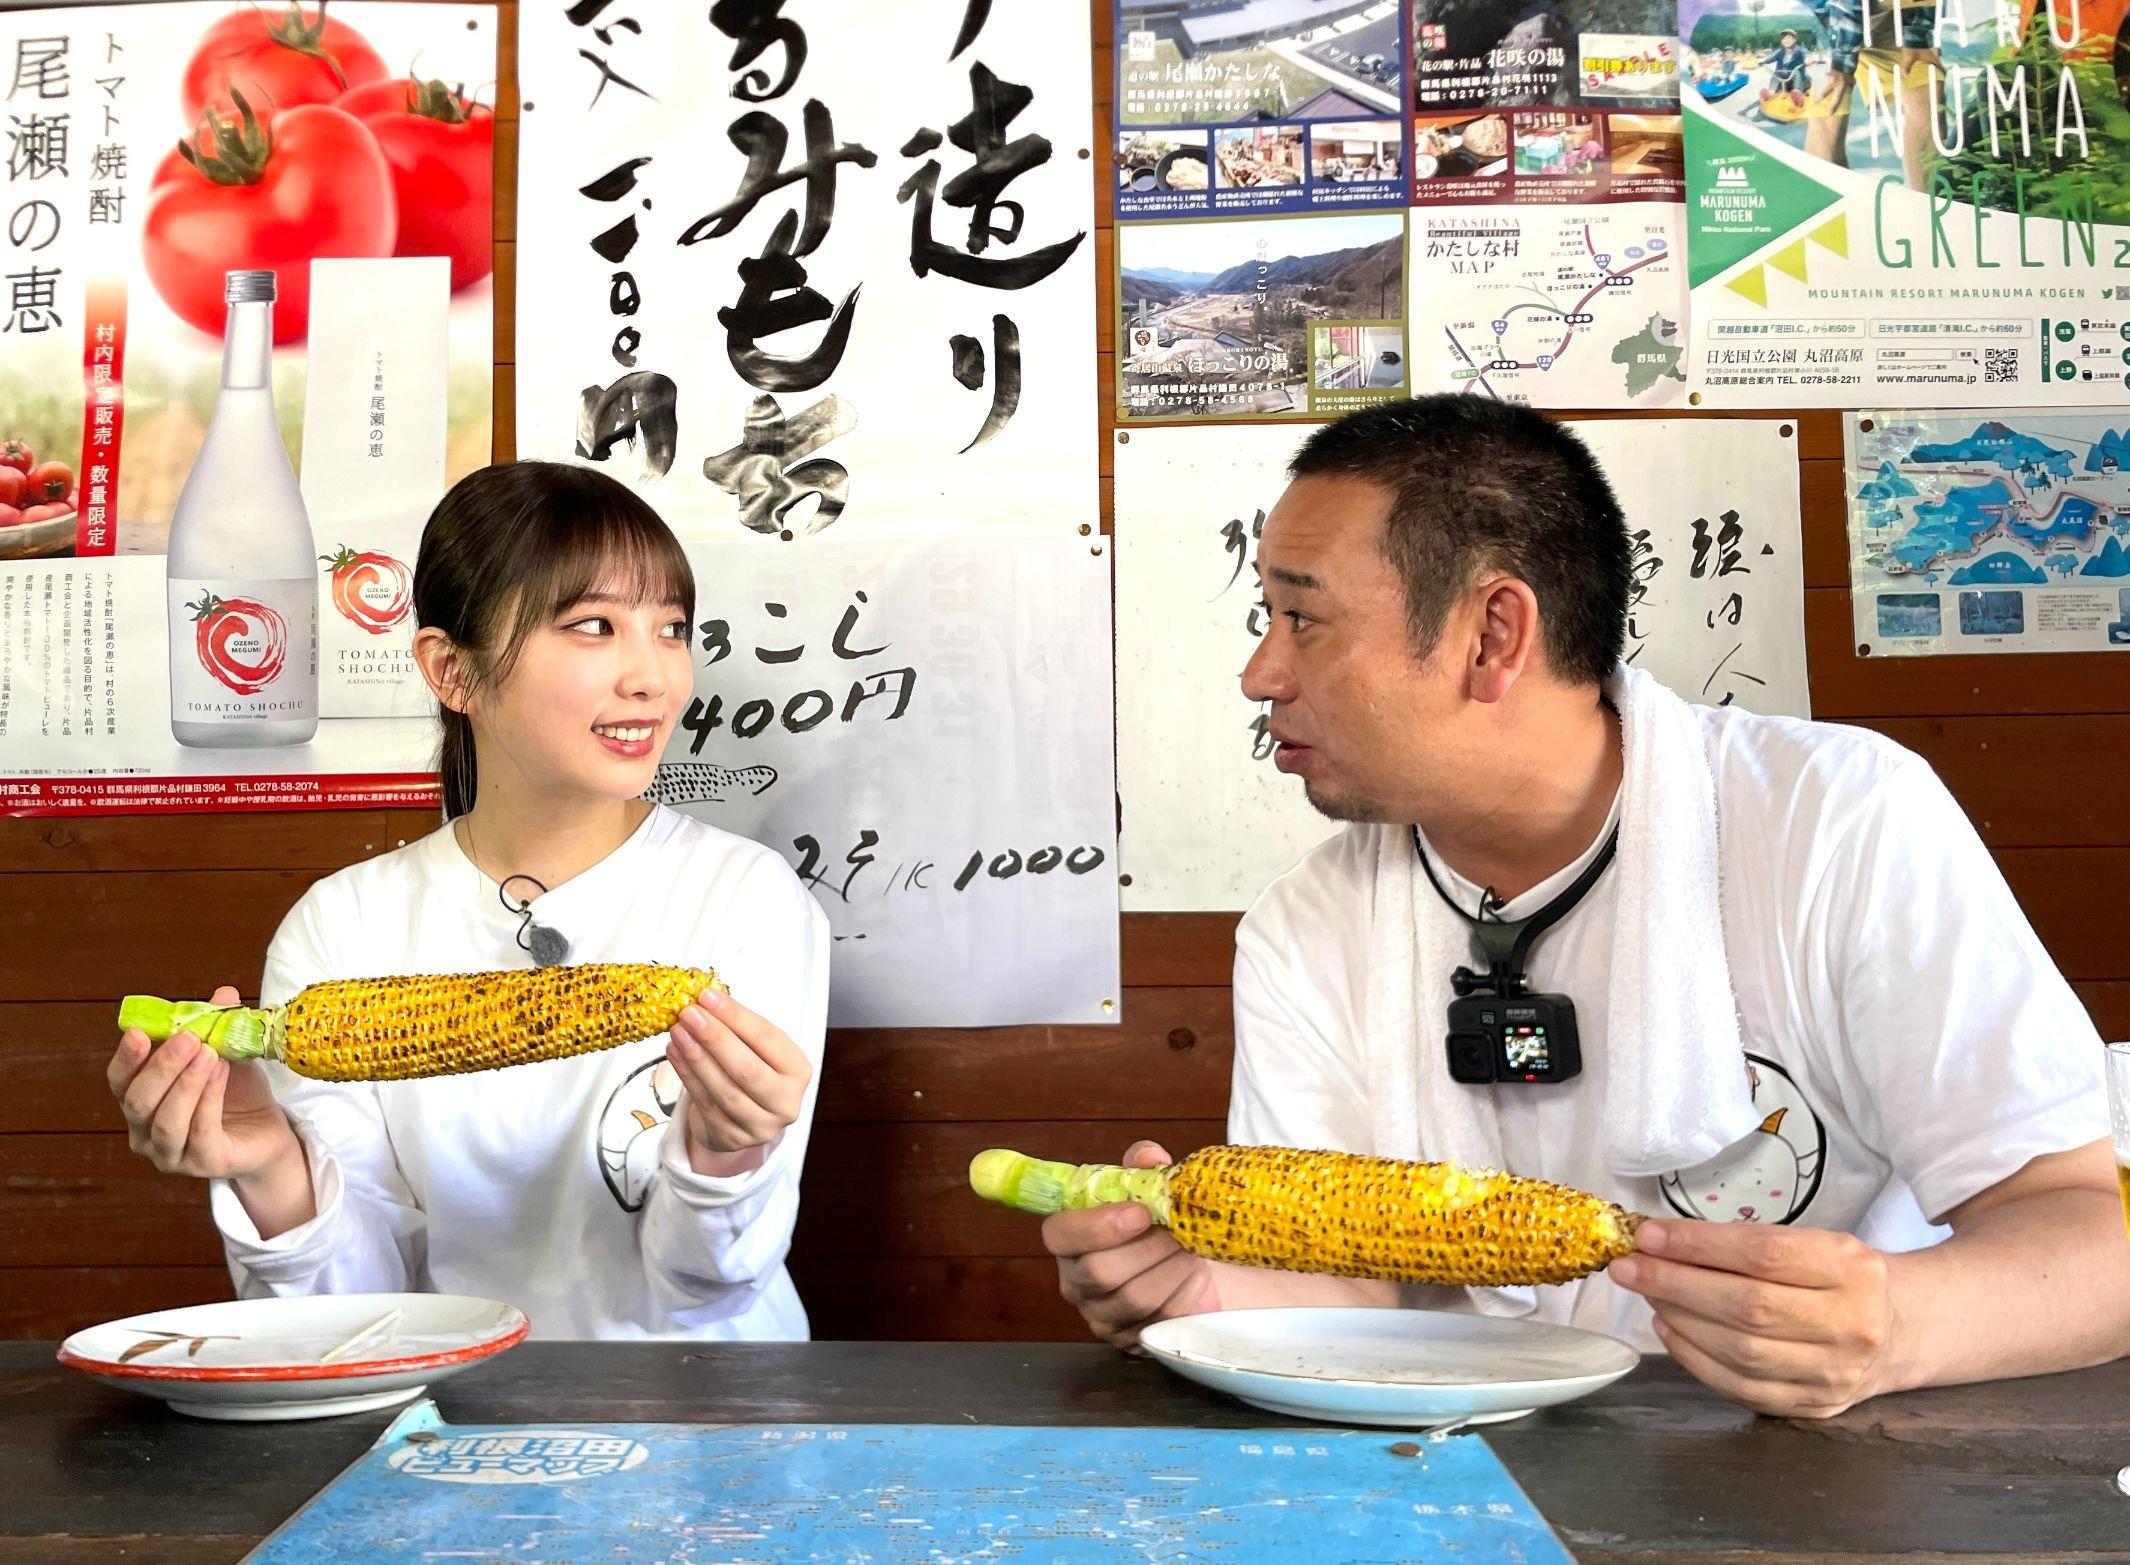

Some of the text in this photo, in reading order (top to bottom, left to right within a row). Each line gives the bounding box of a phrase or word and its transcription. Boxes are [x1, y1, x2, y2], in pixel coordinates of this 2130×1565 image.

[1486, 47, 1566, 69] 花咲の湯
[1165, 61, 1281, 83] 尾瀬かたしな
[1868, 63, 2090, 158] NUMA
[89, 32, 127, 224] トマト焼酎
[1, 35, 71, 334] 尾瀬の恵
[1700, 195, 1766, 208] MARUNUMA
[1428, 219, 1520, 228] KATASHINA
[1714, 209, 1753, 222] KOGEN
[1874, 173, 2096, 269] GREEN
[1427, 240, 1520, 257] かたしな村
[1450, 260, 1495, 274] MAP
[1807, 288, 2085, 299] MOUNTAIN RESORT MARUNUMA KOGEN
[1637, 353, 1667, 364] 群馬県
[1707, 348, 1864, 364] 日光国立公園 丸沼高原
[1704, 376, 1862, 385] 丸沼高原総合案内 TEL. 0278-58-2211
[1876, 374, 1977, 385] www.marunuma.jp
[86, 323, 117, 547] 村内限定販売・数量限定
[368, 396, 386, 458] 尾瀬の恵
[338, 664, 415, 674] SHOCHU
[188, 700, 304, 712] TOMATO SHOCHU
[680, 666, 917, 757] 400円
[51, 785, 105, 795] 〒378-0415
[234, 781, 319, 792] TEL.0278-58-2074
[953, 845, 1106, 892] 1000
